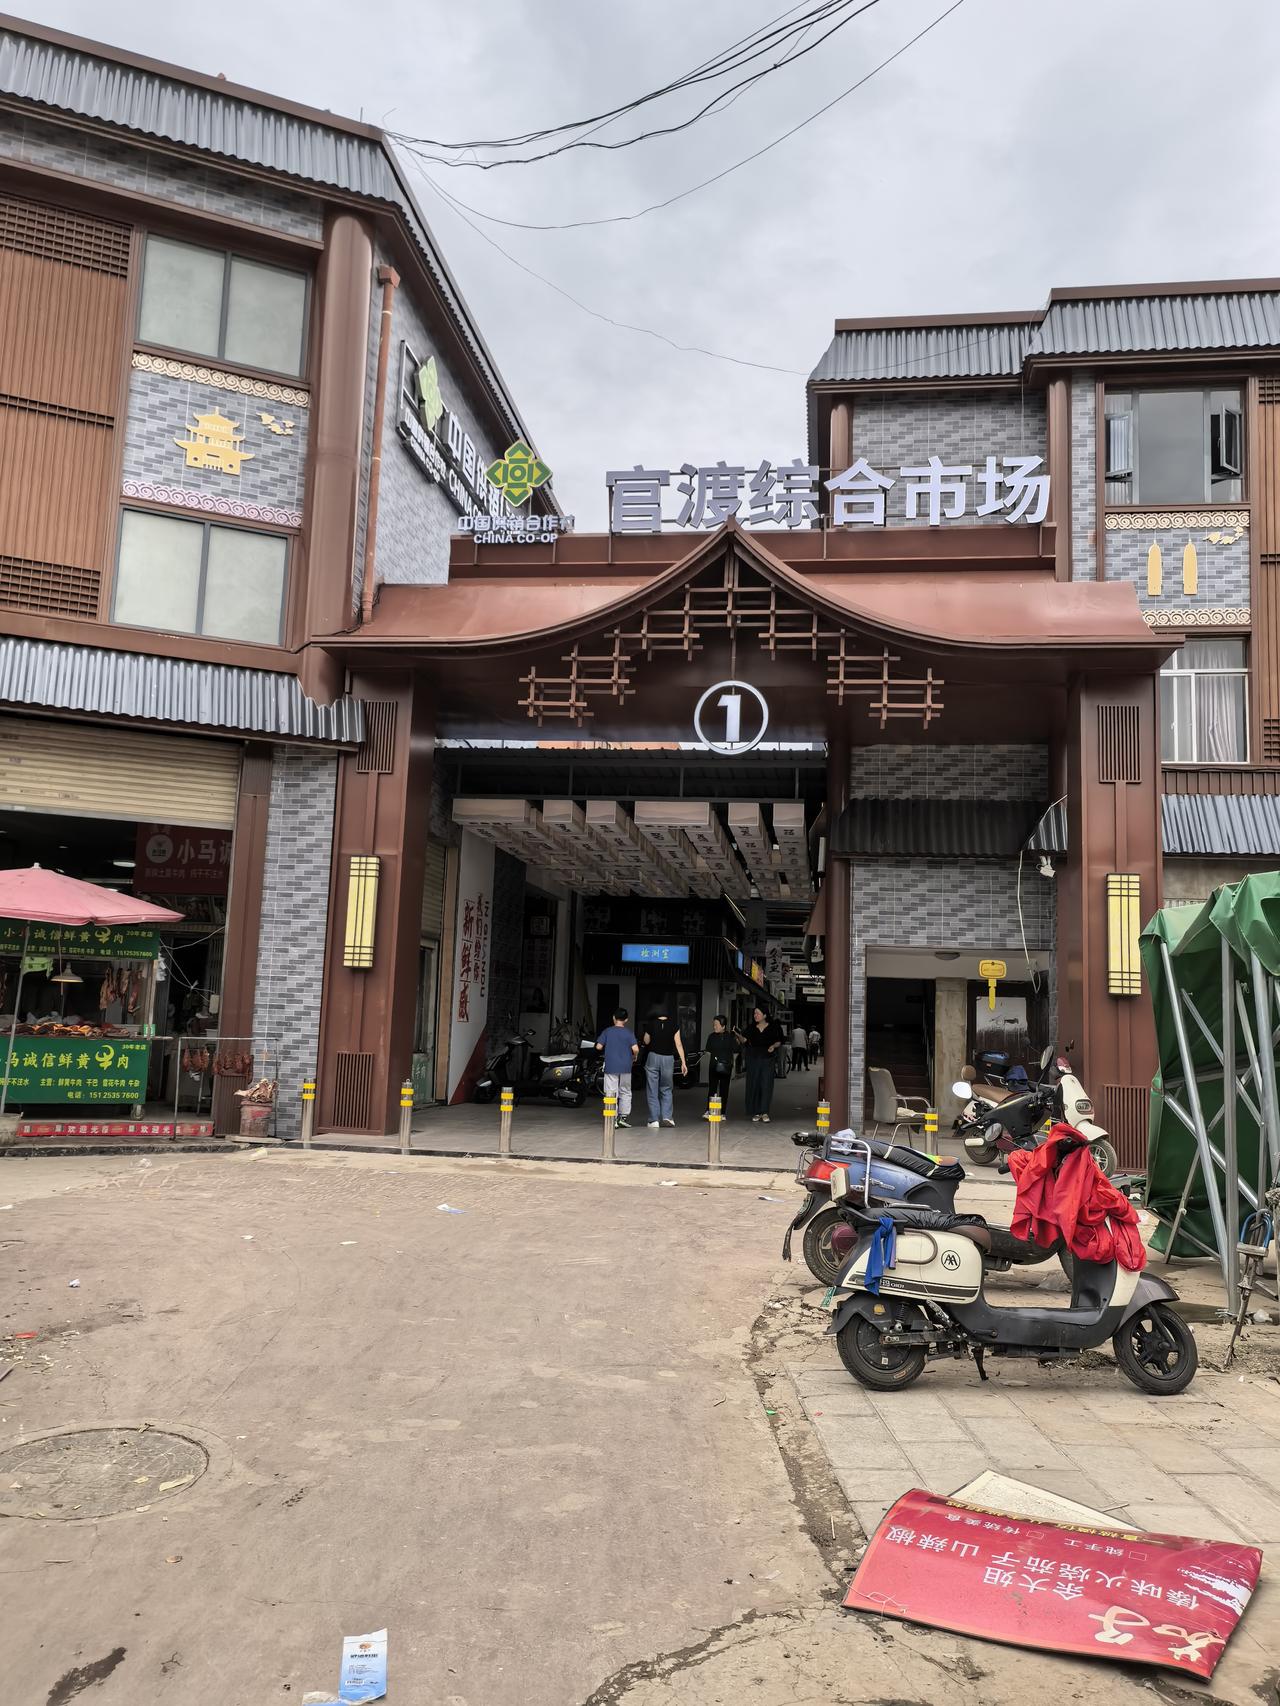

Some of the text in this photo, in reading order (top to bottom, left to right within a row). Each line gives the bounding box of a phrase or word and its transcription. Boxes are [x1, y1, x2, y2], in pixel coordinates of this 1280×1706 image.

[605, 455, 1052, 534] 官渡综合市场
[474, 532, 559, 544] CHINA CO-OP
[0, 1044, 129, 1071] 马诚信鲜黄牛肉
[944, 1513, 1124, 1558] 纯手工 传统美食
[885, 1525, 1200, 1612] 傣味火烧茄子 山辣椒
[981, 1566, 1085, 1602] 余大姐
